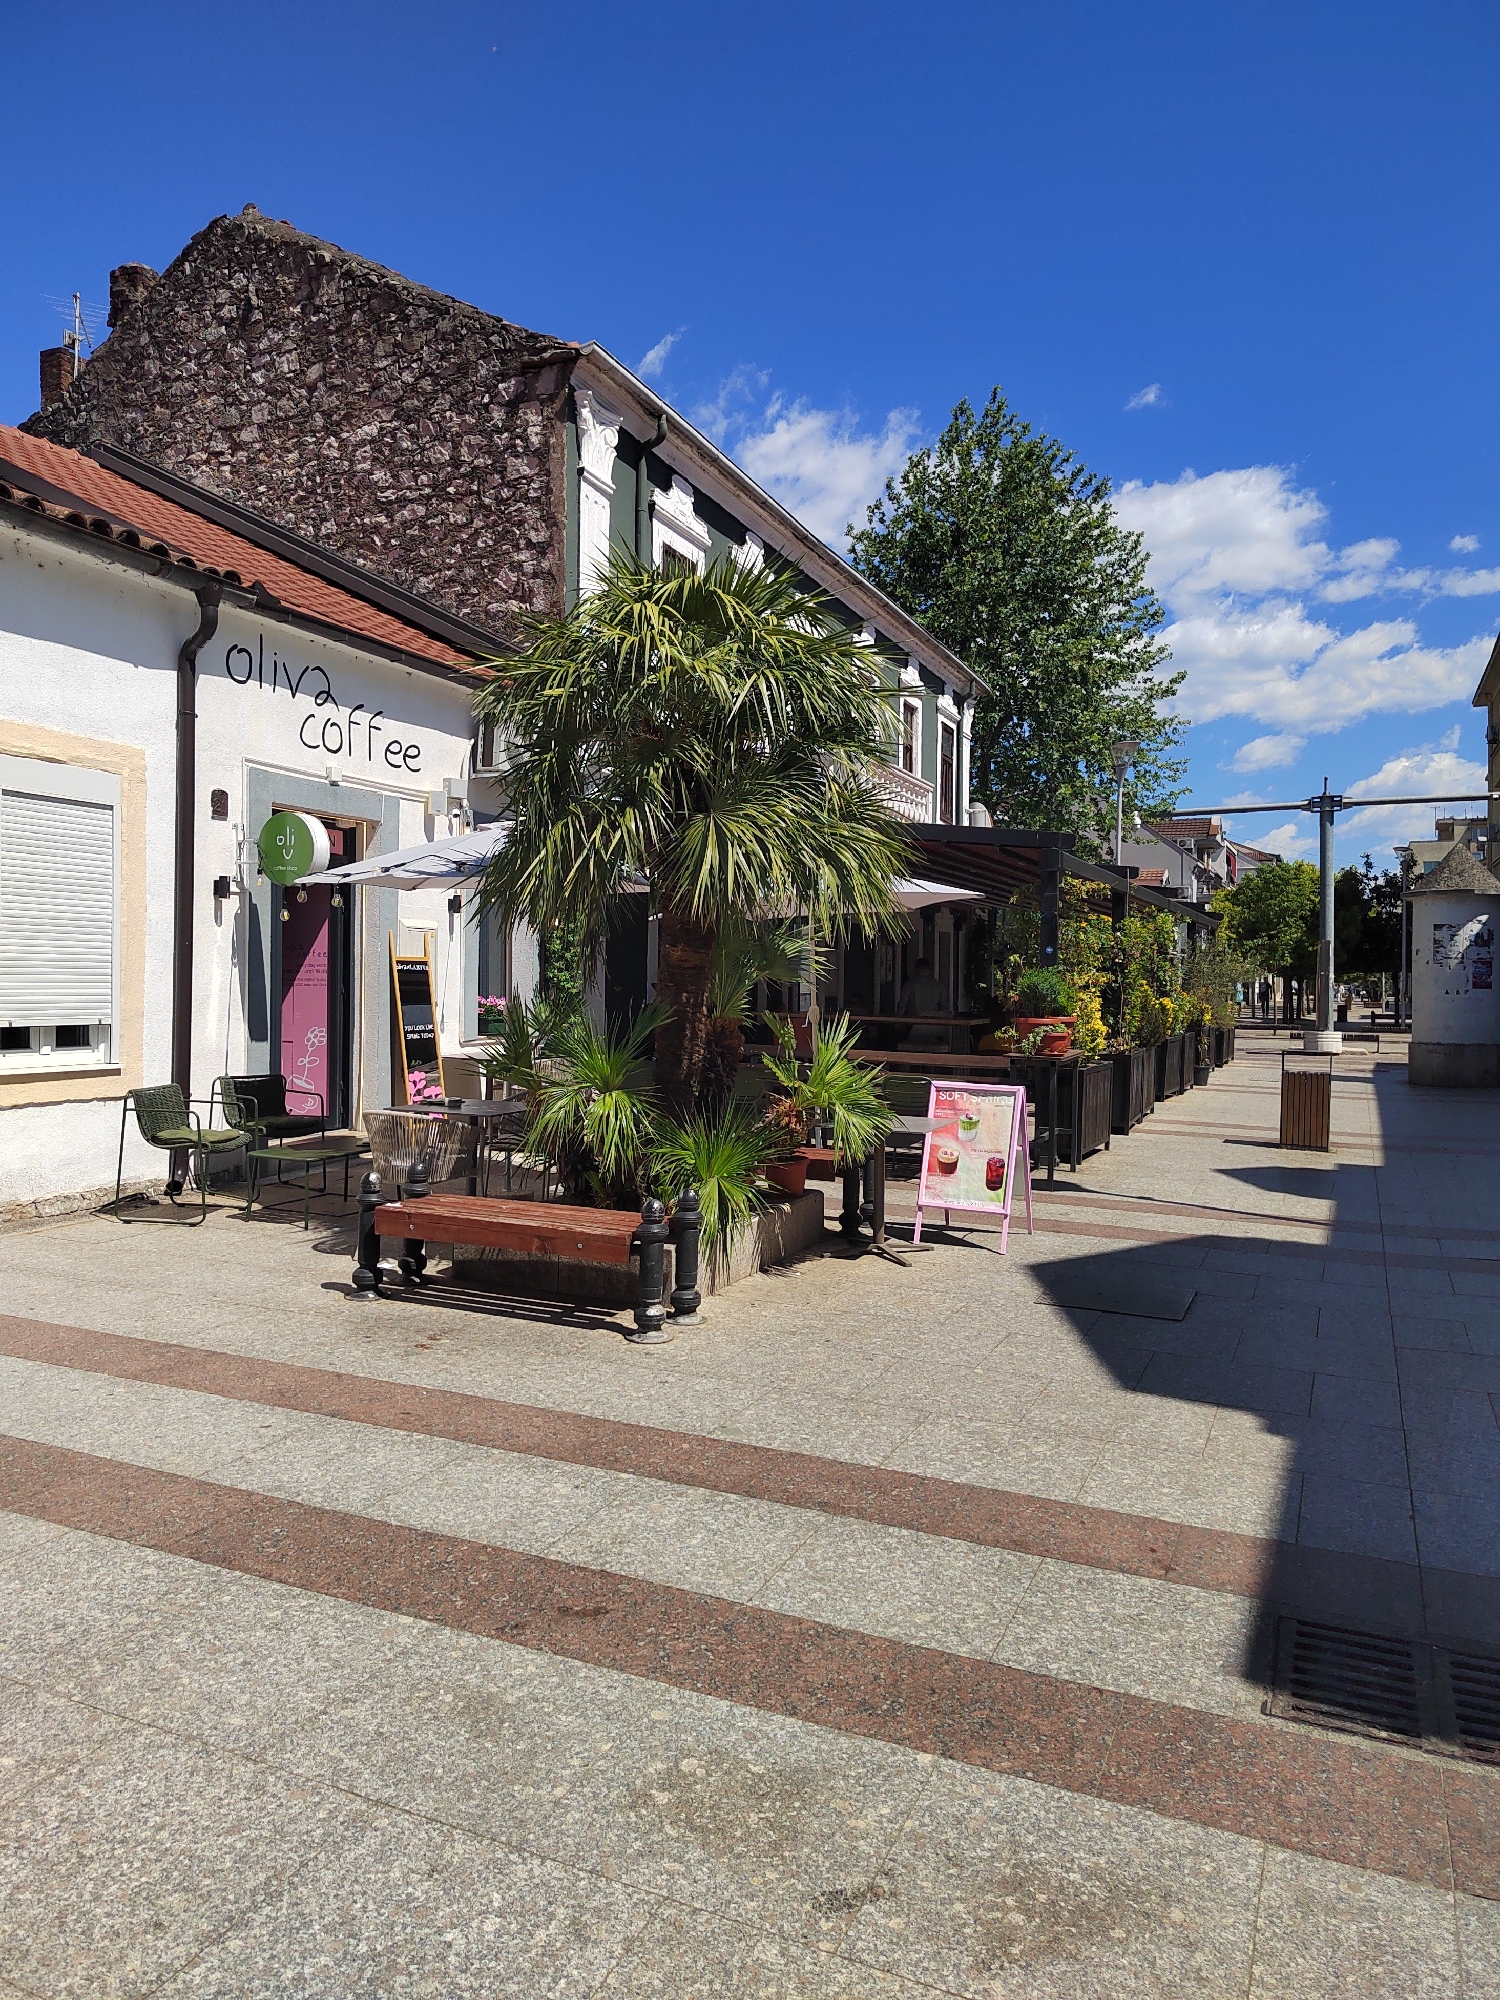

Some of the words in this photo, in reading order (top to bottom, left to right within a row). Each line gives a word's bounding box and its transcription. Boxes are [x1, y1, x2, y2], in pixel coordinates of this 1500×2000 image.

[226, 633, 340, 712] oliva
[300, 704, 421, 773] coffee
[939, 1091, 967, 1102] SOFT
[971, 1093, 1014, 1104] SPRING
